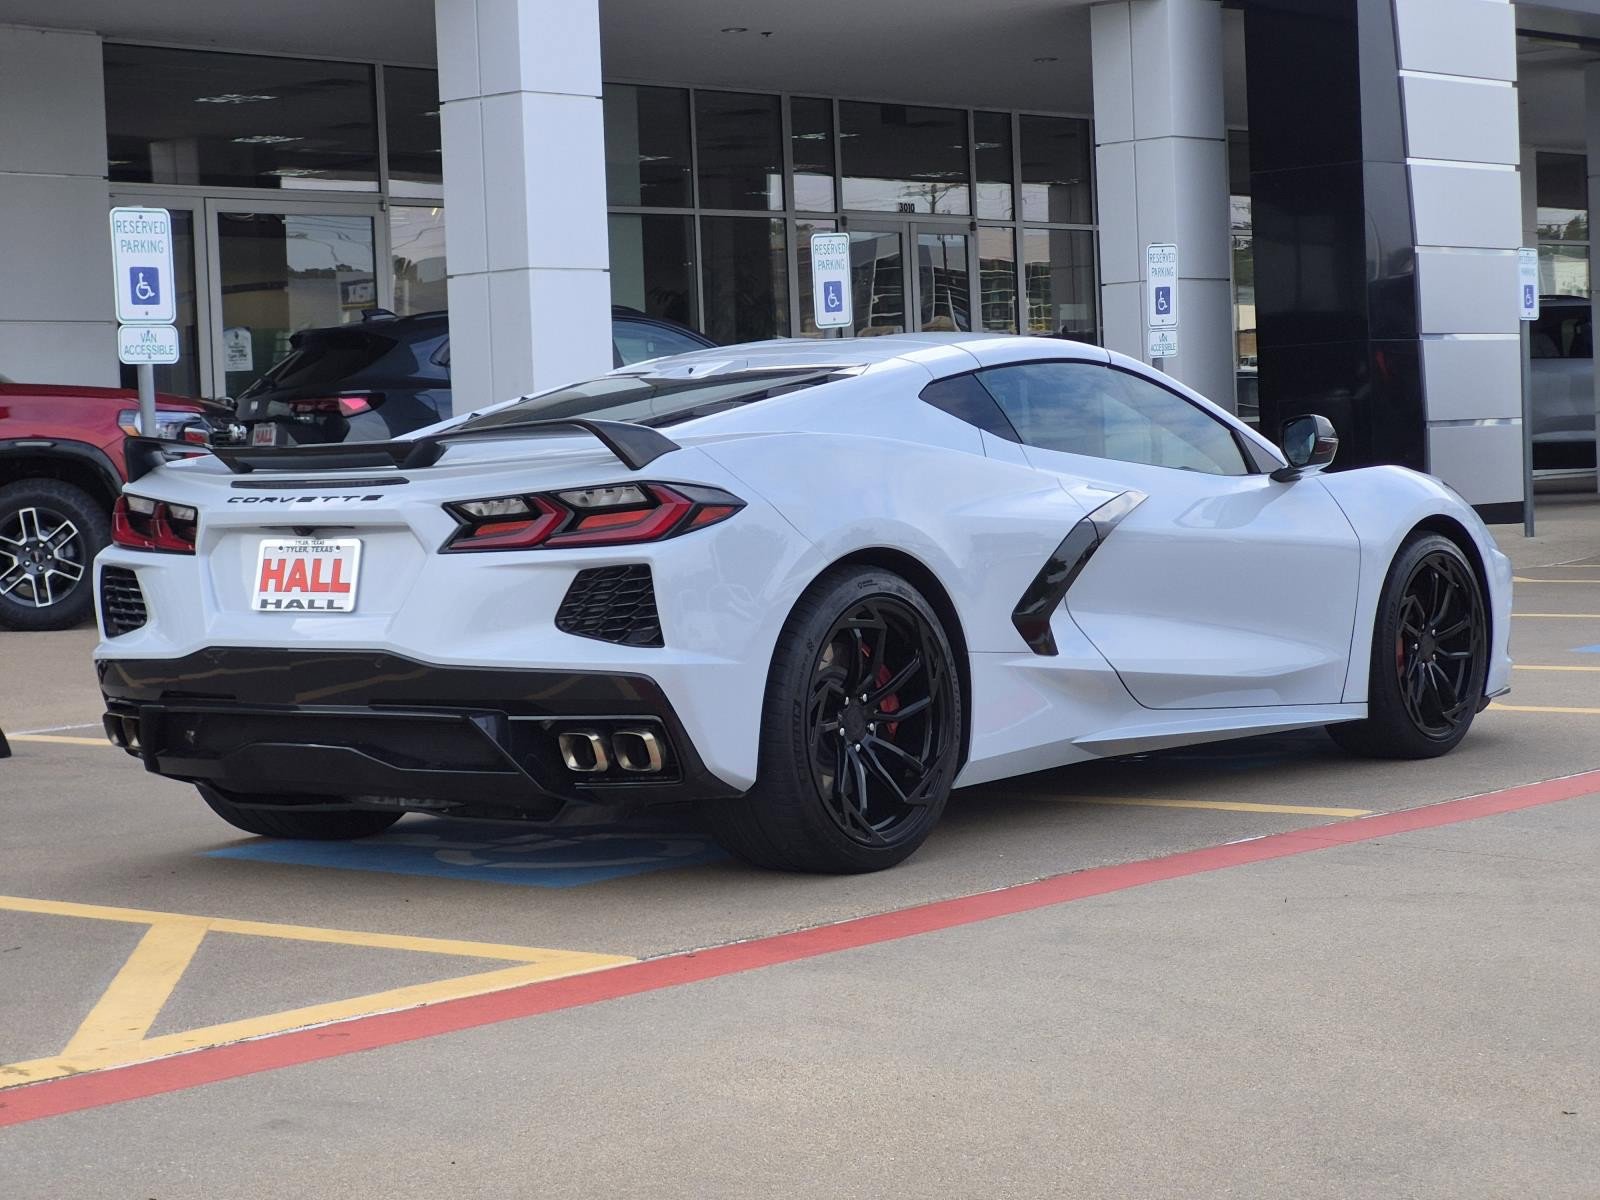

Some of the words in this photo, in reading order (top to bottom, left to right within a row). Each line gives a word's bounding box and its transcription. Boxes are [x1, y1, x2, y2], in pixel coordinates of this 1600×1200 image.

[899, 202, 915, 213] 3010
[116, 220, 166, 234] RESERVED
[121, 239, 165, 253] PARKING
[814, 243, 846, 255] RESERVED
[1150, 252, 1175, 263] RESERVED
[817, 259, 845, 271] PARKING
[1151, 266, 1174, 278] PARKING
[140, 332, 157, 343] VAN
[124, 344, 175, 355] ACCESSIBLE
[227, 494, 384, 503] CORVETTE
[259, 558, 351, 593] HALL
[260, 599, 344, 610] HALL
